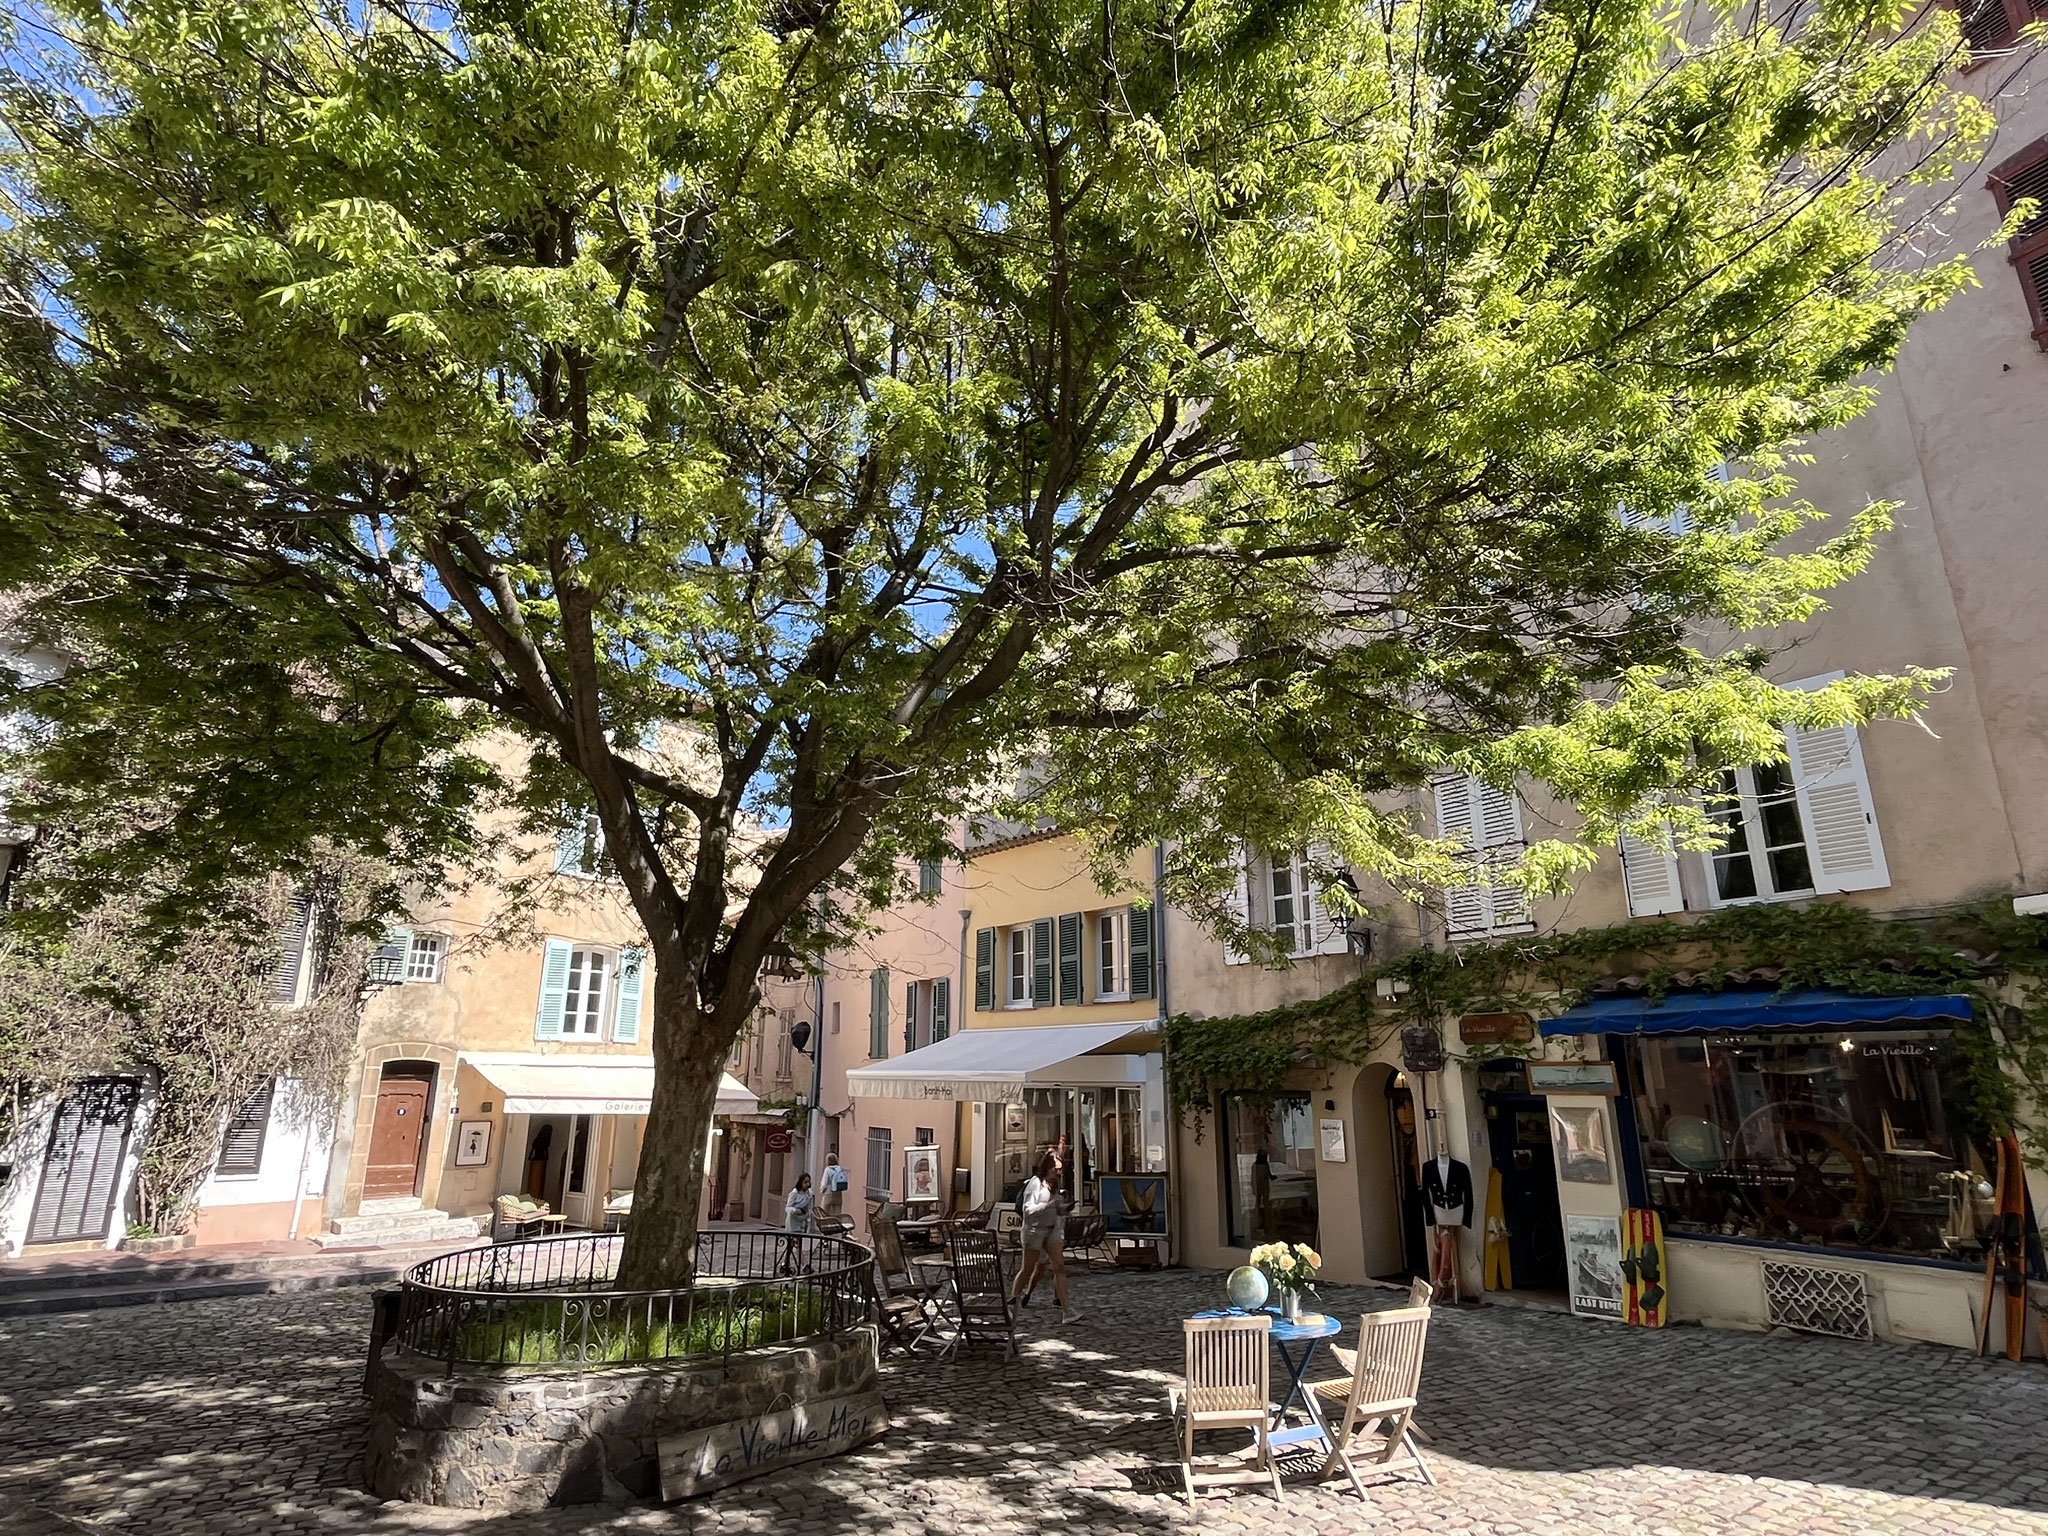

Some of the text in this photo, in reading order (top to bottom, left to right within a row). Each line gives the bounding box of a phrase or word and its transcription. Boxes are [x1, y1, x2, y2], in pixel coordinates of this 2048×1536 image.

[1862, 1044, 1925, 1057] La Vieille
[694, 1405, 873, 1482] La Vieille Mer
